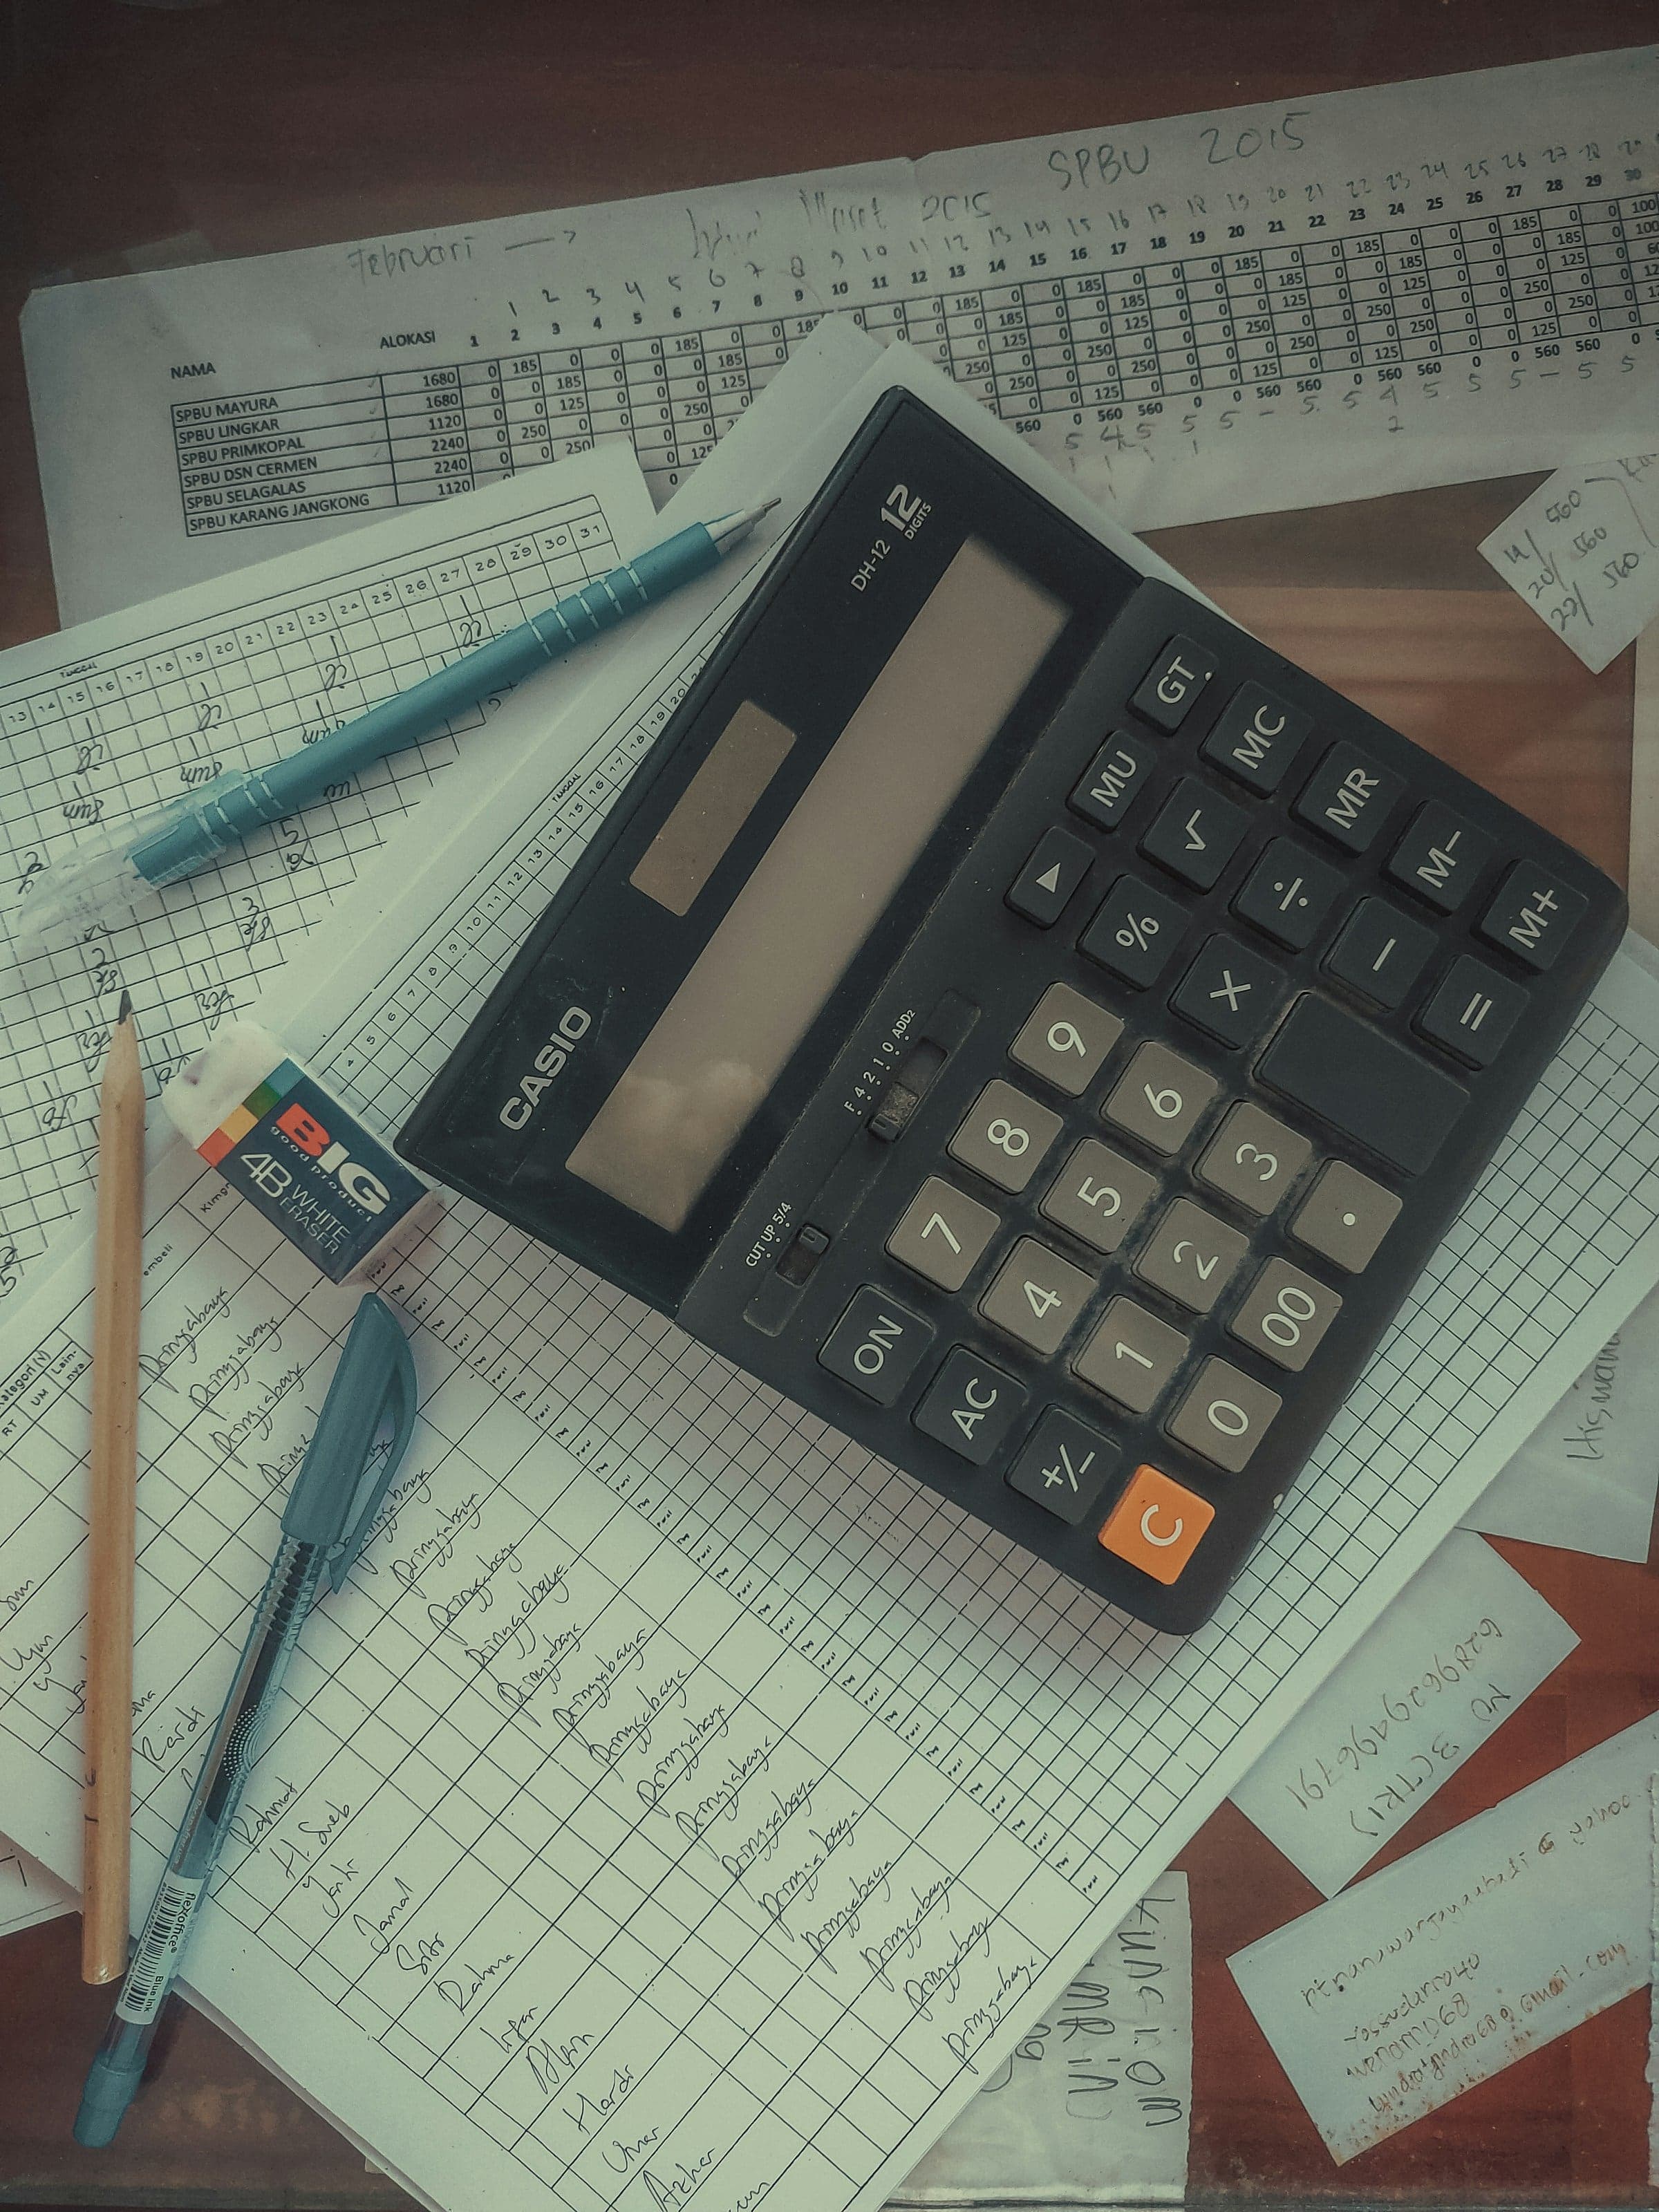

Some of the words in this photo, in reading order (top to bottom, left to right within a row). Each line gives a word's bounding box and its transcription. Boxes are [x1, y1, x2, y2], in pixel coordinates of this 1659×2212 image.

[1047, 144, 1149, 191] SPBU
[1200, 111, 1311, 166] 2015
[171, 362, 216, 379] NAMA
[380, 330, 435, 349] ALOKASI
[471, 336, 478, 346] 1
[511, 330, 520, 341] 2
[552, 323, 561, 334] 3
[593, 317, 602, 329] 4
[634, 312, 642, 324] 5
[673, 307, 682, 318] 6
[712, 301, 720, 312] 7
[753, 295, 762, 306] 8
[795, 290, 803, 301] 9
[832, 282, 848, 294] 10
[872, 276, 889, 289] 11
[911, 271, 928, 283] 12
[949, 265, 966, 277] 13
[989, 260, 1005, 272] 14
[1029, 254, 1047, 266] 15
[1071, 247, 1087, 261] 16
[1111, 243, 1126, 255] 17
[1150, 236, 1167, 250] 18
[1190, 232, 1205, 243] 19
[1228, 225, 1244, 238] 20
[1268, 221, 1285, 232] 21
[1309, 215, 1326, 227] 22
[1349, 209, 1366, 221] 23
[1388, 203, 1405, 216] 24
[1427, 197, 1443, 210] 25
[1466, 191, 1483, 204] 26
[1506, 185, 1521, 198] 27
[1546, 180, 1564, 192] 28
[1585, 174, 1602, 187] 29
[176, 406, 212, 422] SPBU
[216, 397, 279, 418] MAYURA
[423, 372, 456, 386] 1680
[1077, 279, 1102, 292] 185
[179, 427, 215, 444] SPBU
[218, 419, 280, 438] LINGKAR
[426, 394, 459, 409] 1680
[1557, 231, 1582, 244] 185
[1575, 338, 1601, 353] 560
[182, 450, 218, 466] SPBU
[221, 438, 306, 460] PRIMKOPAL
[429, 416, 462, 431] 1120
[560, 397, 585, 411] 125
[185, 471, 221, 487] SPBU
[224, 469, 253, 483] DSN
[256, 457, 317, 478] CERMEN
[431, 437, 465, 452] 2240
[1246, 320, 1271, 333] 250
[190, 515, 226, 531] SPBU
[229, 505, 290, 526] KARANG
[292, 494, 370, 517] JANGKONG
[438, 480, 471, 496] 1120
[1532, 323, 1557, 337] 125
[187, 493, 223, 509] SPBU
[227, 481, 306, 504] SELAGALAS
[434, 458, 467, 474] 2240
[1009, 375, 1035, 390] 250
[881, 485, 922, 532] 12
[904, 503, 932, 540] DIGITS
[440, 568, 461, 583] 27
[544, 535, 568, 550] 30
[580, 525, 601, 538] 31
[850, 540, 890, 592] DH-12
[1156, 656, 1196, 704] GT
[1232, 705, 1286, 770] MC
[527, 849, 543, 865] 13
[569, 803, 584, 819] 15
[589, 780, 605, 796] 16
[630, 735, 645, 750] 18
[1090, 750, 1137, 808] MU
[1324, 767, 1380, 830] MR
[1116, 912, 1160, 953] %
[1508, 889, 1559, 950] M+
[500, 1006, 592, 1130] CASIO
[1047, 1022, 1087, 1058] 9
[844, 1101, 855, 1112] F
[854, 1086, 865, 1098] 4
[863, 1071, 876, 1084] 2
[873, 1056, 884, 1068] 1
[882, 1042, 894, 1053] 0
[1143, 1082, 1183, 1118] 6
[270, 1126, 310, 1162] good
[276, 1103, 391, 1215] BIG
[987, 1118, 1030, 1157] 8
[1235, 1143, 1278, 1181] 3
[241, 1153, 293, 1198] 4B
[1076, 1177, 1122, 1217] 5
[279, 1197, 340, 1255] ERASER
[291, 1184, 350, 1244] WHITE
[745, 1241, 767, 1267] CUT
[760, 1224, 775, 1244] UP
[772, 1201, 792, 1226] 5/4
[921, 1212, 963, 1255] 7
[1173, 1241, 1219, 1281] 2
[1023, 1280, 1062, 1319] 4
[1261, 1287, 1316, 1347] 00
[853, 1315, 904, 1376] ON
[1115, 1341, 1154, 1370] 1
[1, 1418, 19, 1437] RT
[30, 1389, 50, 1407] UM
[951, 1378, 997, 1441] AC
[1207, 1399, 1250, 1436] 0
[1141, 1503, 1183, 1547] C
[143, 1998, 157, 2013] Ink
[150, 1976, 164, 1996] Blue
